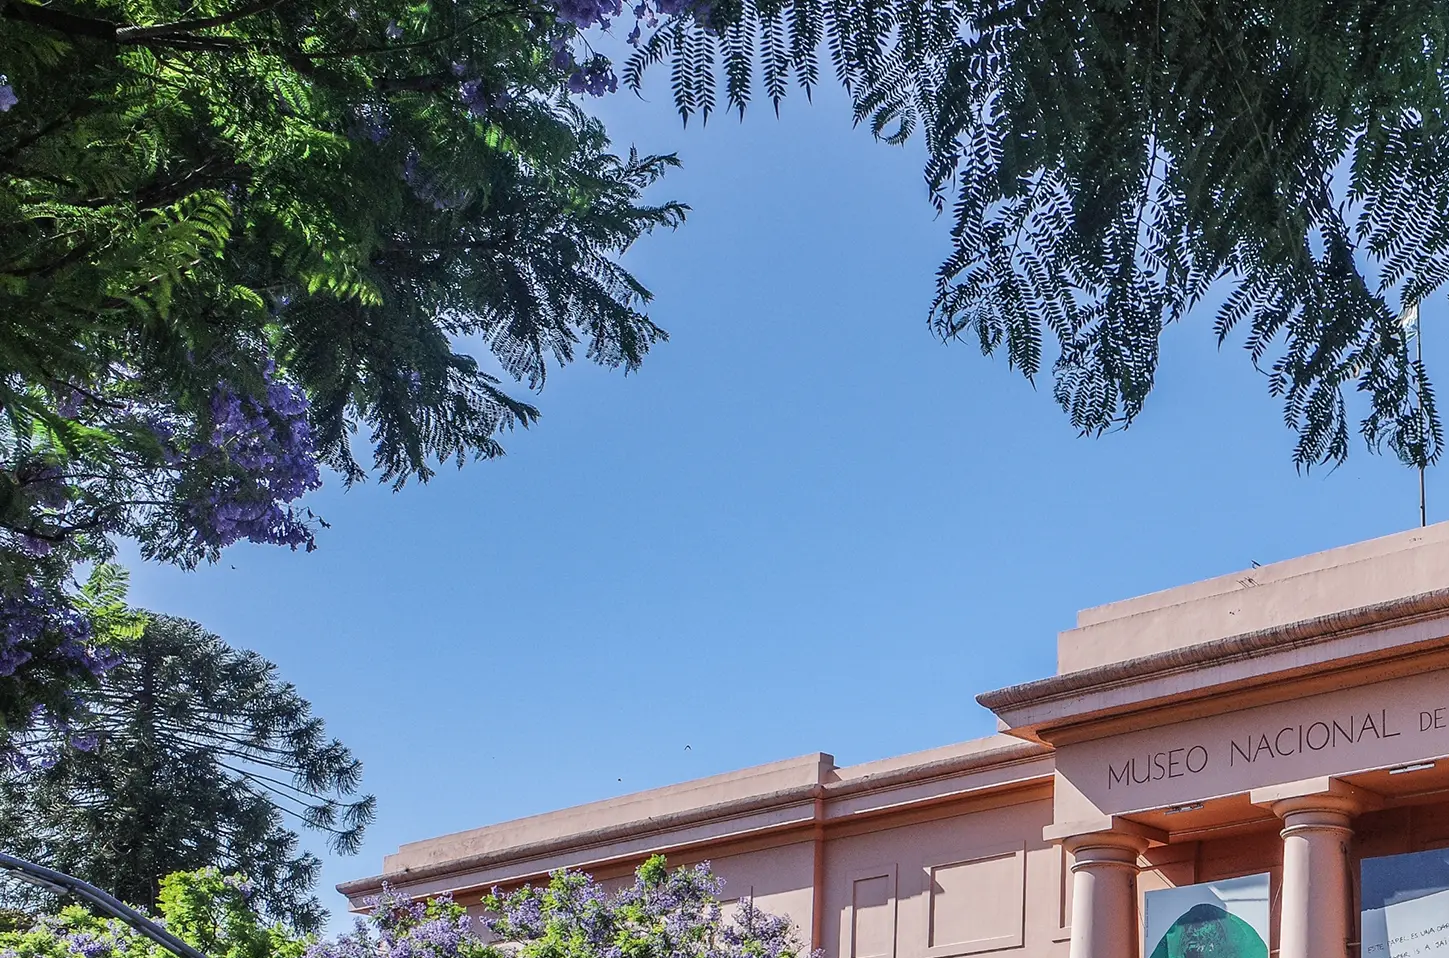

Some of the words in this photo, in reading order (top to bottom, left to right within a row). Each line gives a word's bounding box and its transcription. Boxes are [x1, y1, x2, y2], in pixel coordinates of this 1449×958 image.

[1108, 745, 1208, 790] MUSEO
[1230, 709, 1401, 767] NACIONAL
[1419, 707, 1446, 732] DE
